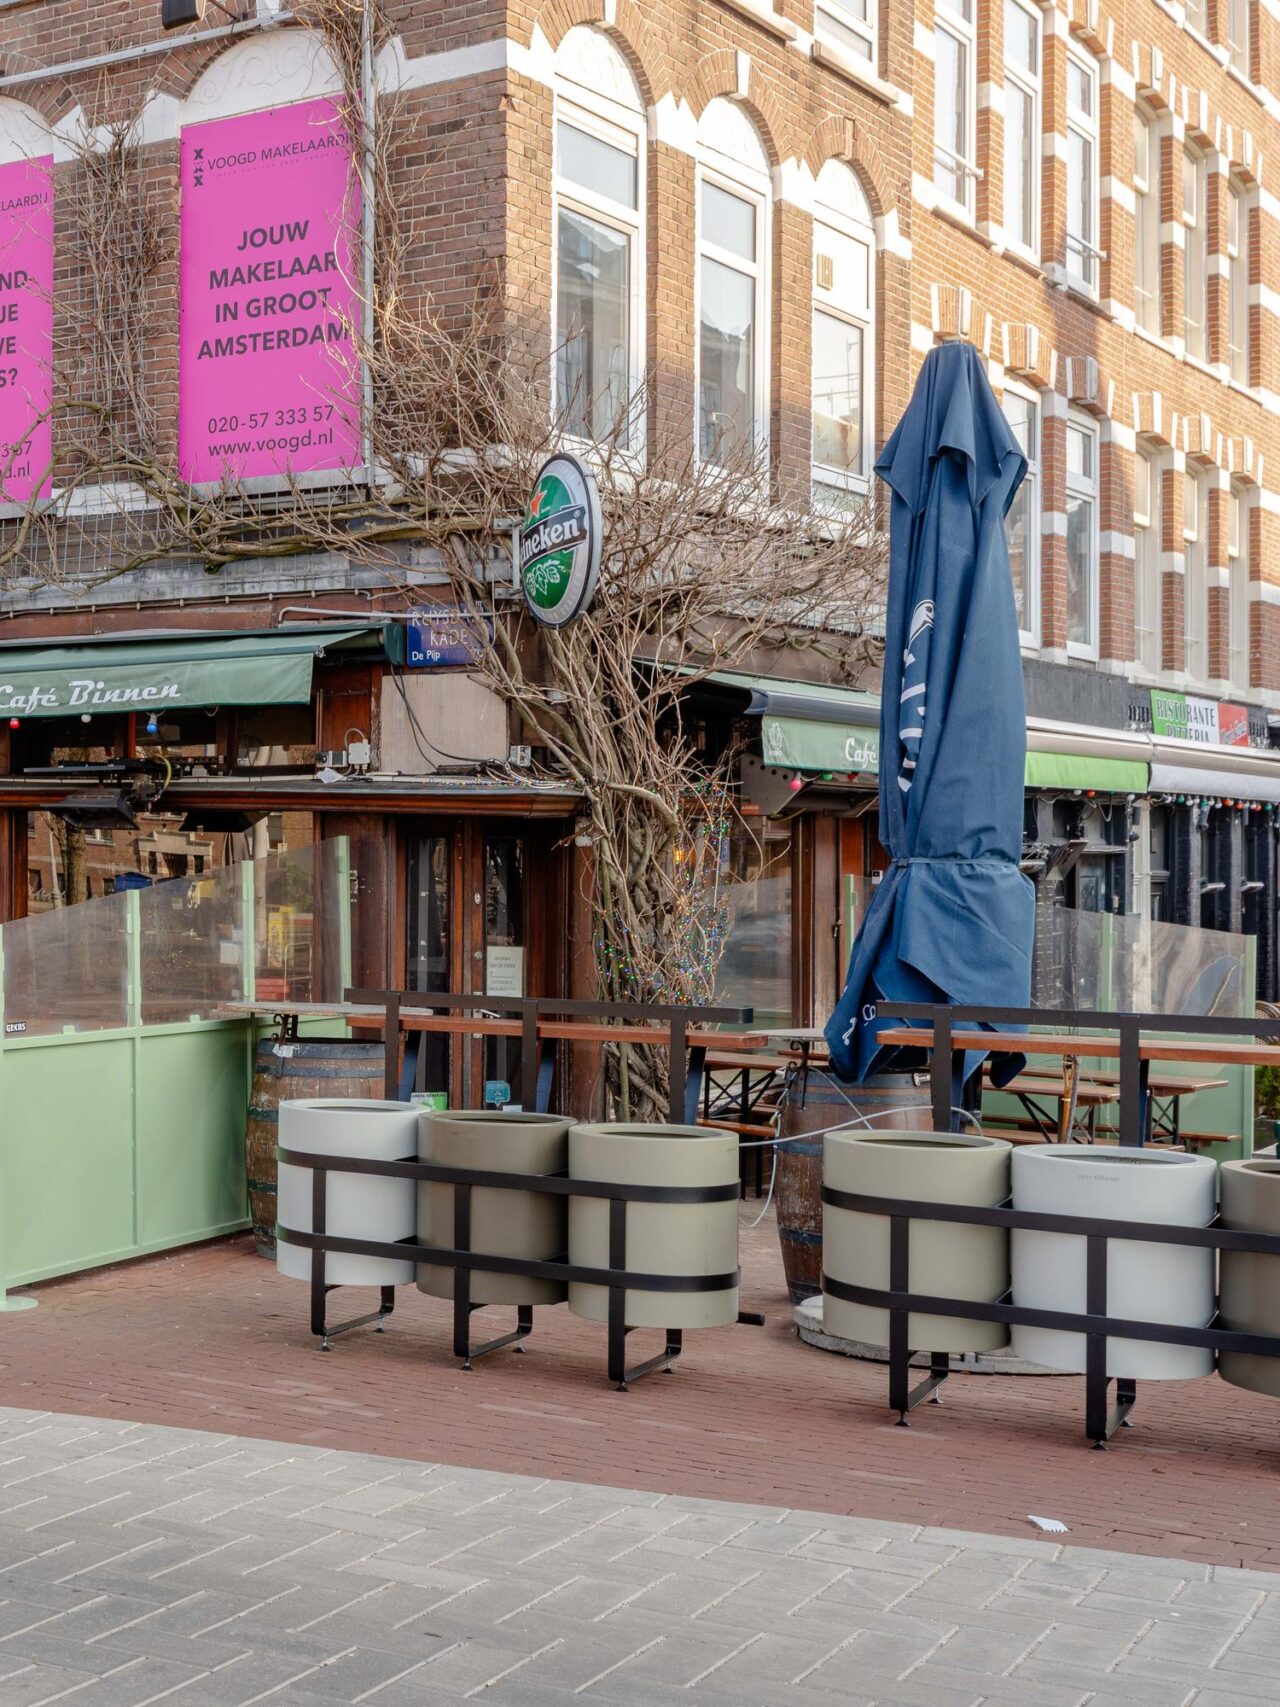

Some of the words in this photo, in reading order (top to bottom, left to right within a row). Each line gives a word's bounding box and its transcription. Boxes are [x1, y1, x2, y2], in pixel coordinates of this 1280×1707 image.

[208, 151, 257, 171] VOOGD
[261, 131, 351, 161] MAKELAARDI
[236, 220, 310, 251] JOUW
[209, 251, 338, 290] MAKELAAR
[215, 301, 238, 324] IN
[245, 287, 332, 319] GROOT
[197, 322, 349, 360] AMSTERDAM
[274, 407, 307, 427] 333
[313, 404, 335, 423] 57
[208, 428, 334, 457] www.voogd.nl
[430, 628, 468, 646] KADE
[411, 651, 424, 661] De
[426, 650, 441, 662] Pijp
[68, 680, 181, 705] Binnen
[1156, 697, 1217, 727] RISTORANTE
[845, 737, 878, 769] Café
